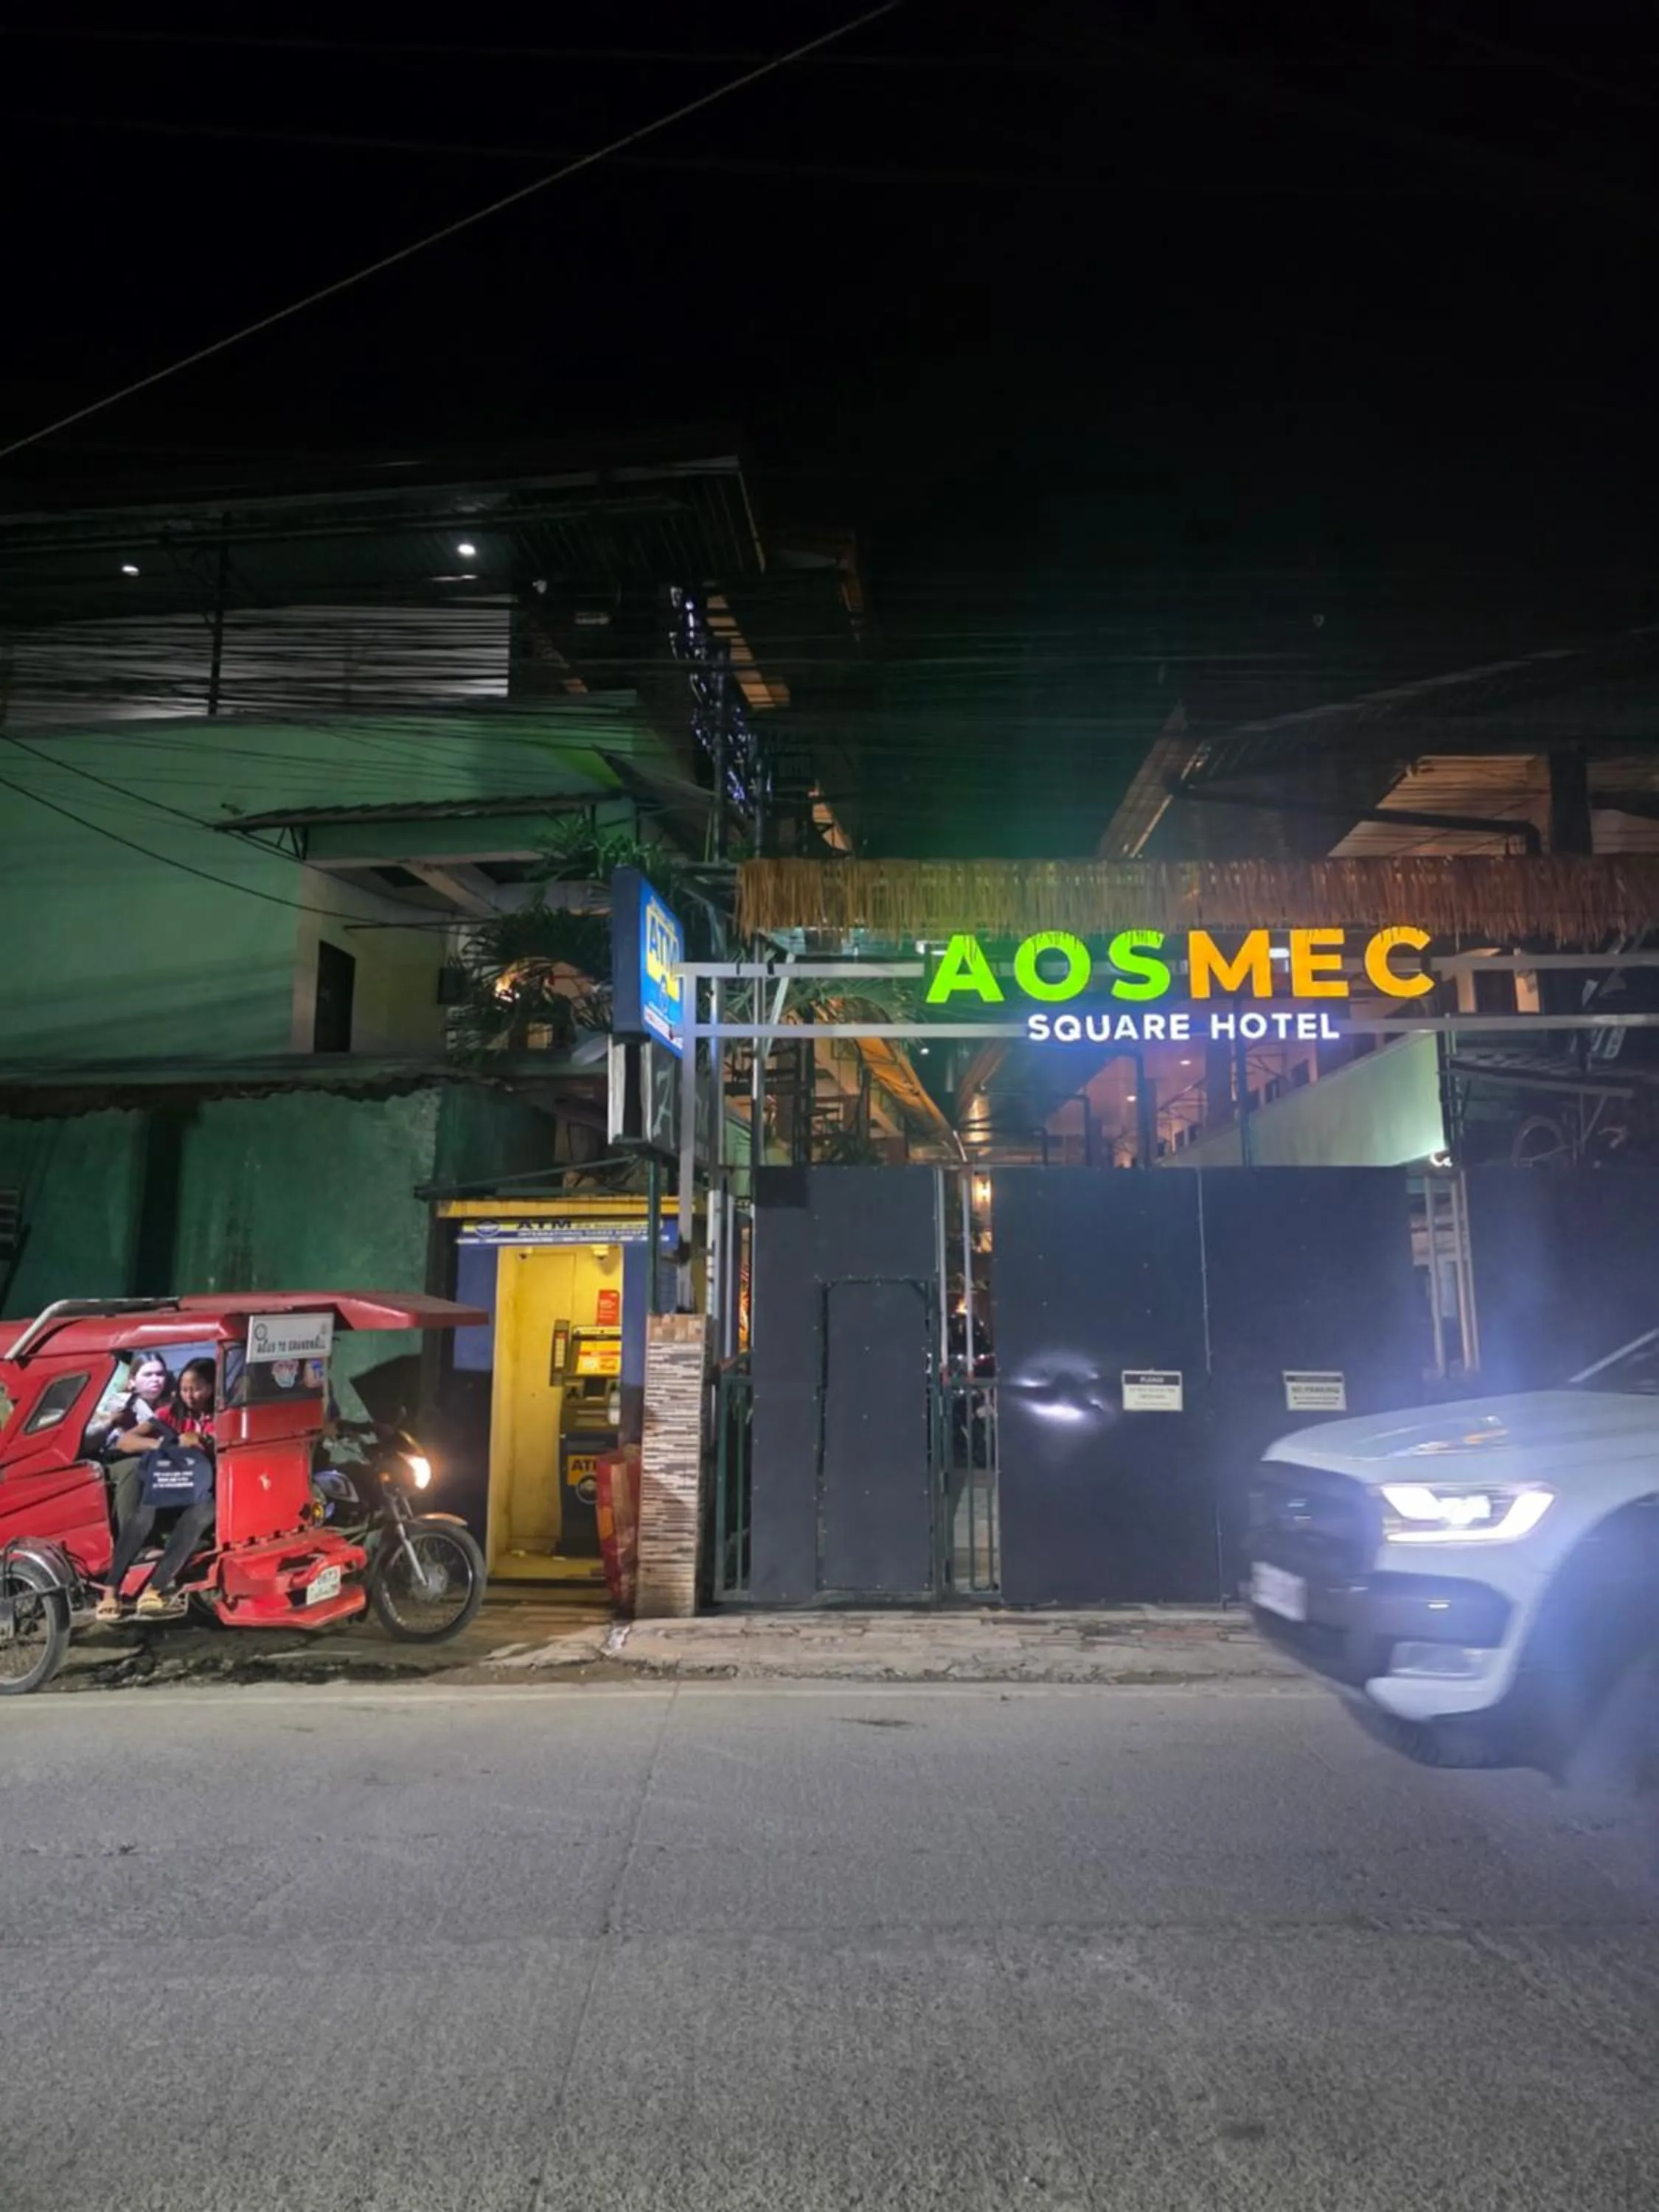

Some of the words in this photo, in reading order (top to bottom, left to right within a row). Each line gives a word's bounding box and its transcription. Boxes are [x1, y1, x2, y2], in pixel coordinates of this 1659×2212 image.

[649, 914, 679, 973] ATM
[926, 926, 1434, 1003] AOSMEC
[1028, 1013, 1190, 1042] SQUARE
[1211, 1012, 1340, 1040] HOTEL
[518, 1220, 572, 1229] ATM
